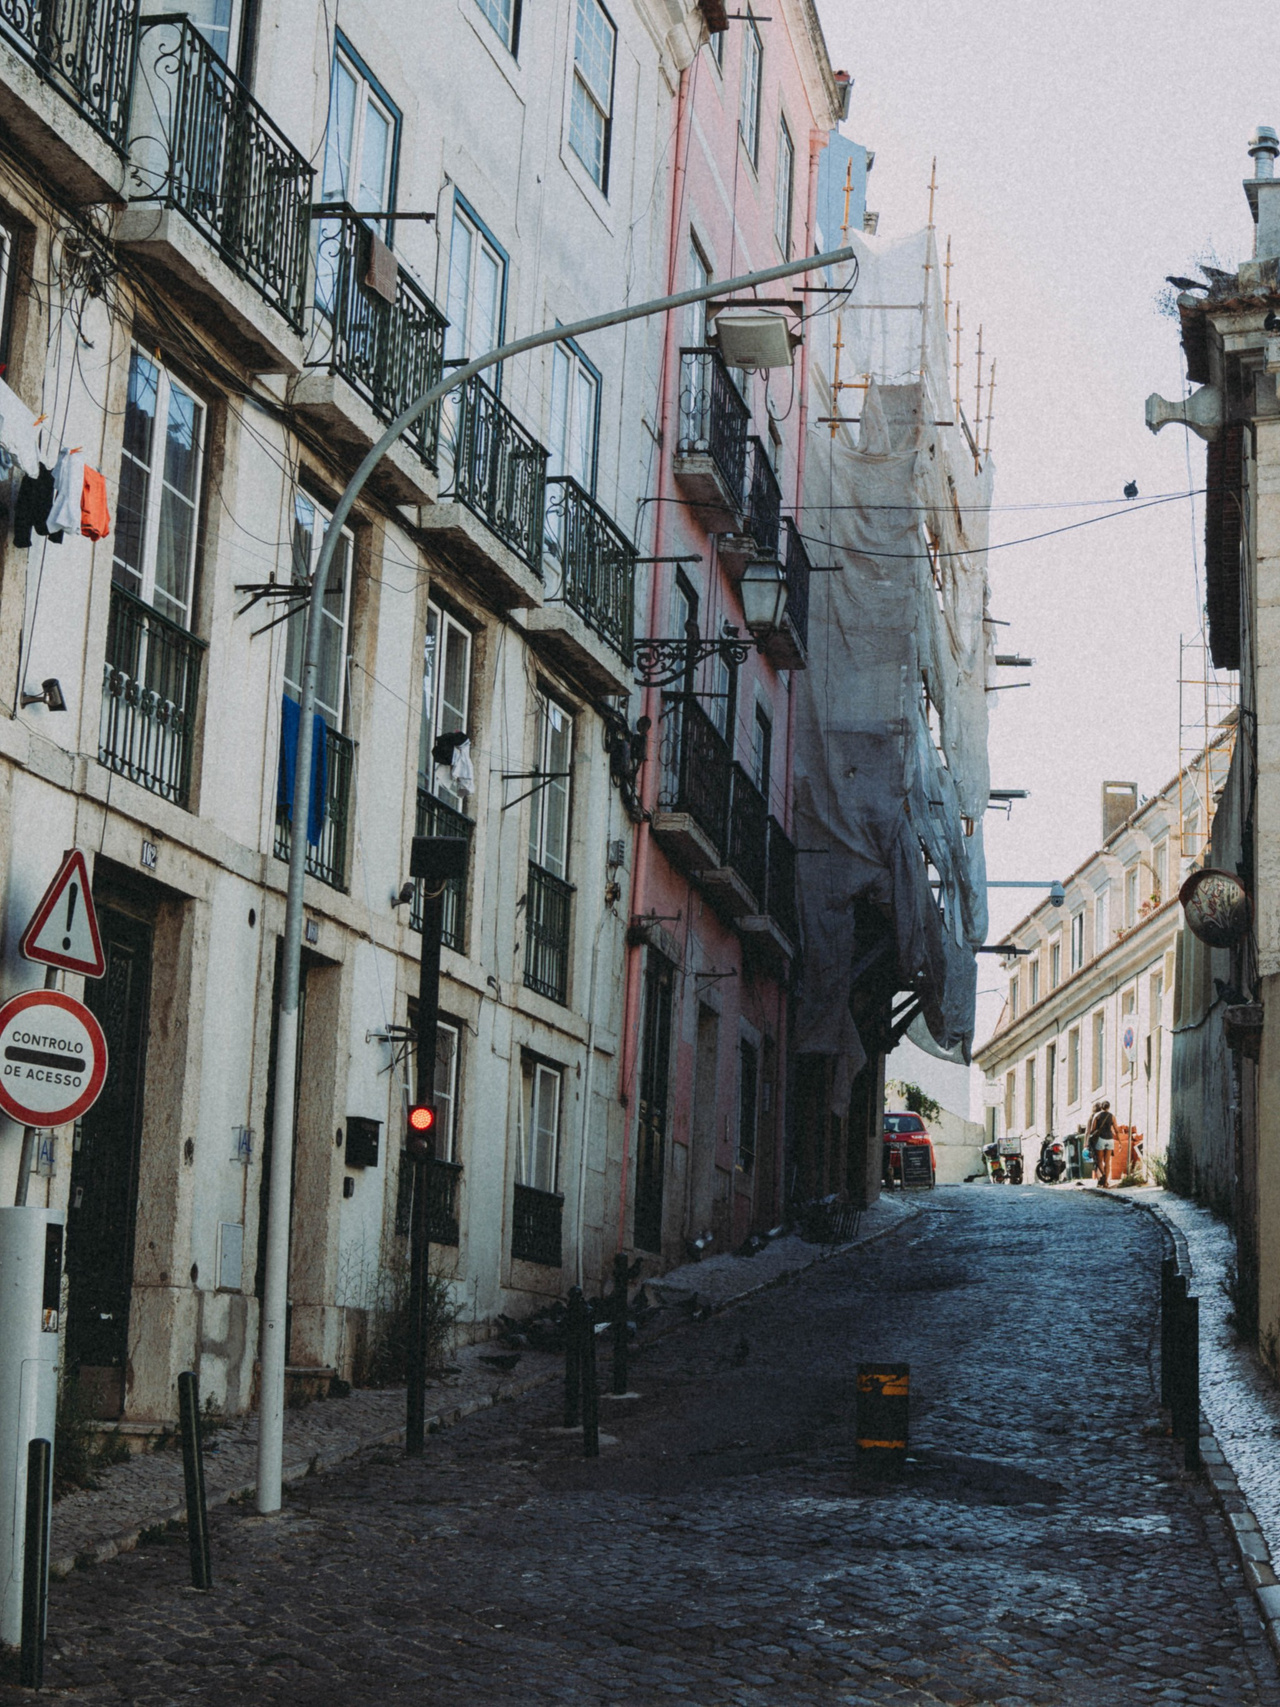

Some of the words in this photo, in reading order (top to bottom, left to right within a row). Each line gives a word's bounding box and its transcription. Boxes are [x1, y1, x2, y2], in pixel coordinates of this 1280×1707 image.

[12, 1030, 84, 1054] CONTROLO
[4, 1064, 22, 1078] DE
[26, 1070, 82, 1088] ACESSO
[40, 1140, 55, 1163] AL
